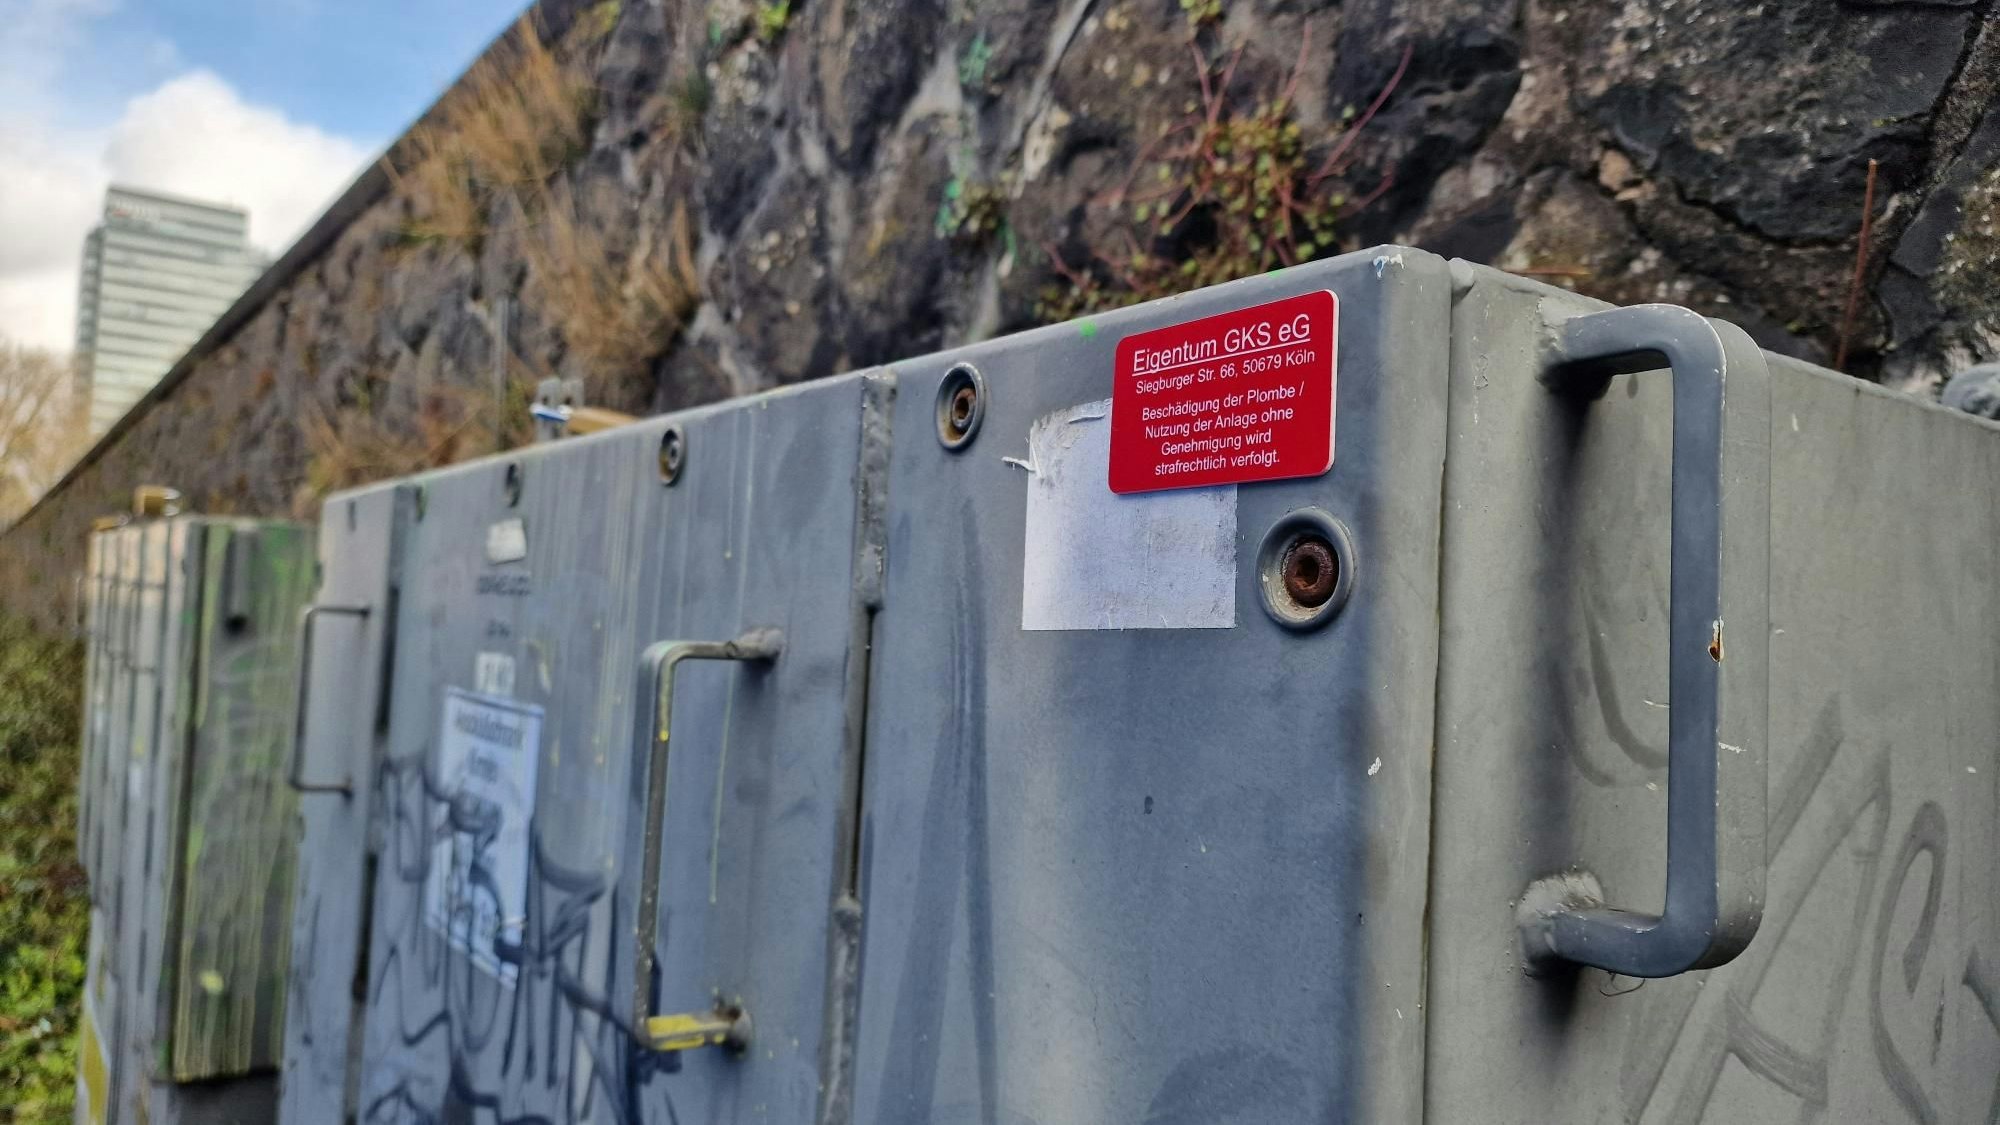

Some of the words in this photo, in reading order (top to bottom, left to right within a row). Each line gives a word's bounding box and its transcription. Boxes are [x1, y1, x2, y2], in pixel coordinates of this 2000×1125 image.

[1133, 339, 1216, 373] Eigentum
[1224, 323, 1270, 352] GKS
[1279, 314, 1310, 342] eG
[1136, 374, 1195, 394] Siegburger
[1198, 369, 1216, 382] Str.
[1220, 365, 1238, 378] 66,
[1243, 354, 1282, 375] 50679
[1286, 350, 1315, 365] Köln
[1142, 398, 1220, 421] Beschädigung
[1224, 394, 1243, 406] der
[1248, 386, 1295, 404] Plombe
[1299, 382, 1305, 396] /
[1145, 421, 1190, 439] Nutzung
[1194, 418, 1212, 431] der
[1215, 412, 1257, 428] Anlage
[1261, 407, 1293, 421] ohne
[1162, 437, 1241, 456] Genehmigung
[1246, 429, 1271, 445] wird
[1155, 455, 1226, 475] strafrechtlich
[1231, 451, 1280, 468] verfolgt.
